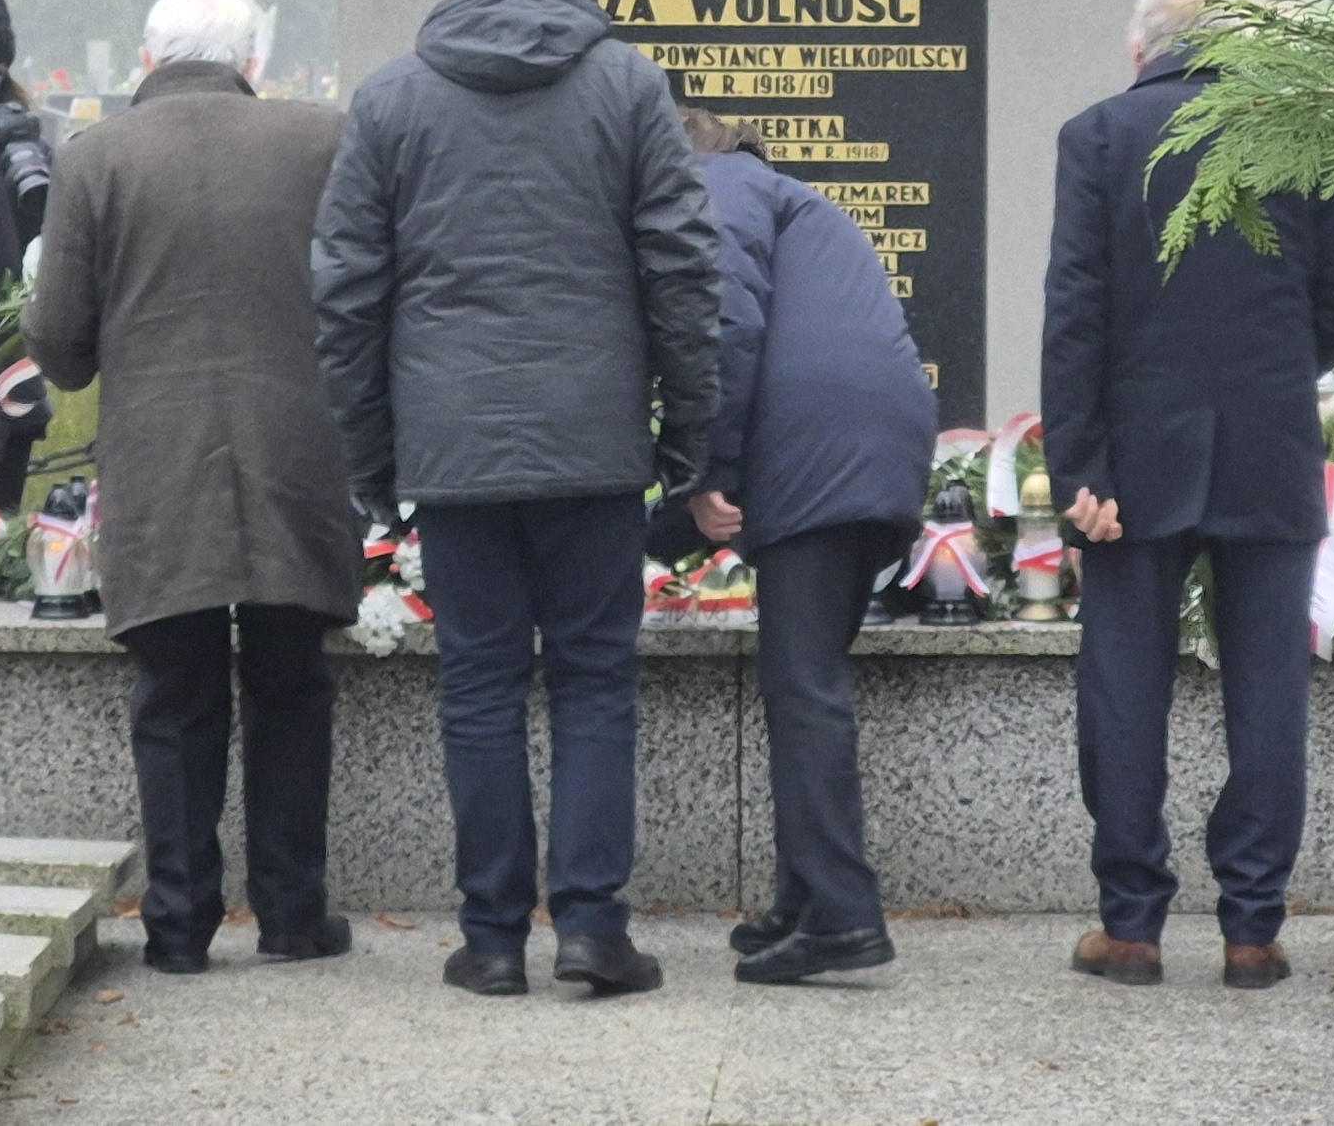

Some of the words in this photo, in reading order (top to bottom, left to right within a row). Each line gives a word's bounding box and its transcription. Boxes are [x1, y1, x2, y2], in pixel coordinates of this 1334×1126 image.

[653, 46, 785, 67] POWSTANCY
[799, 46, 964, 68] WIELKOPOLSCY
[688, 74, 707, 94] W
[723, 74, 743, 94] R.
[753, 74, 830, 94] 1918/19
[800, 145, 815, 159] W
